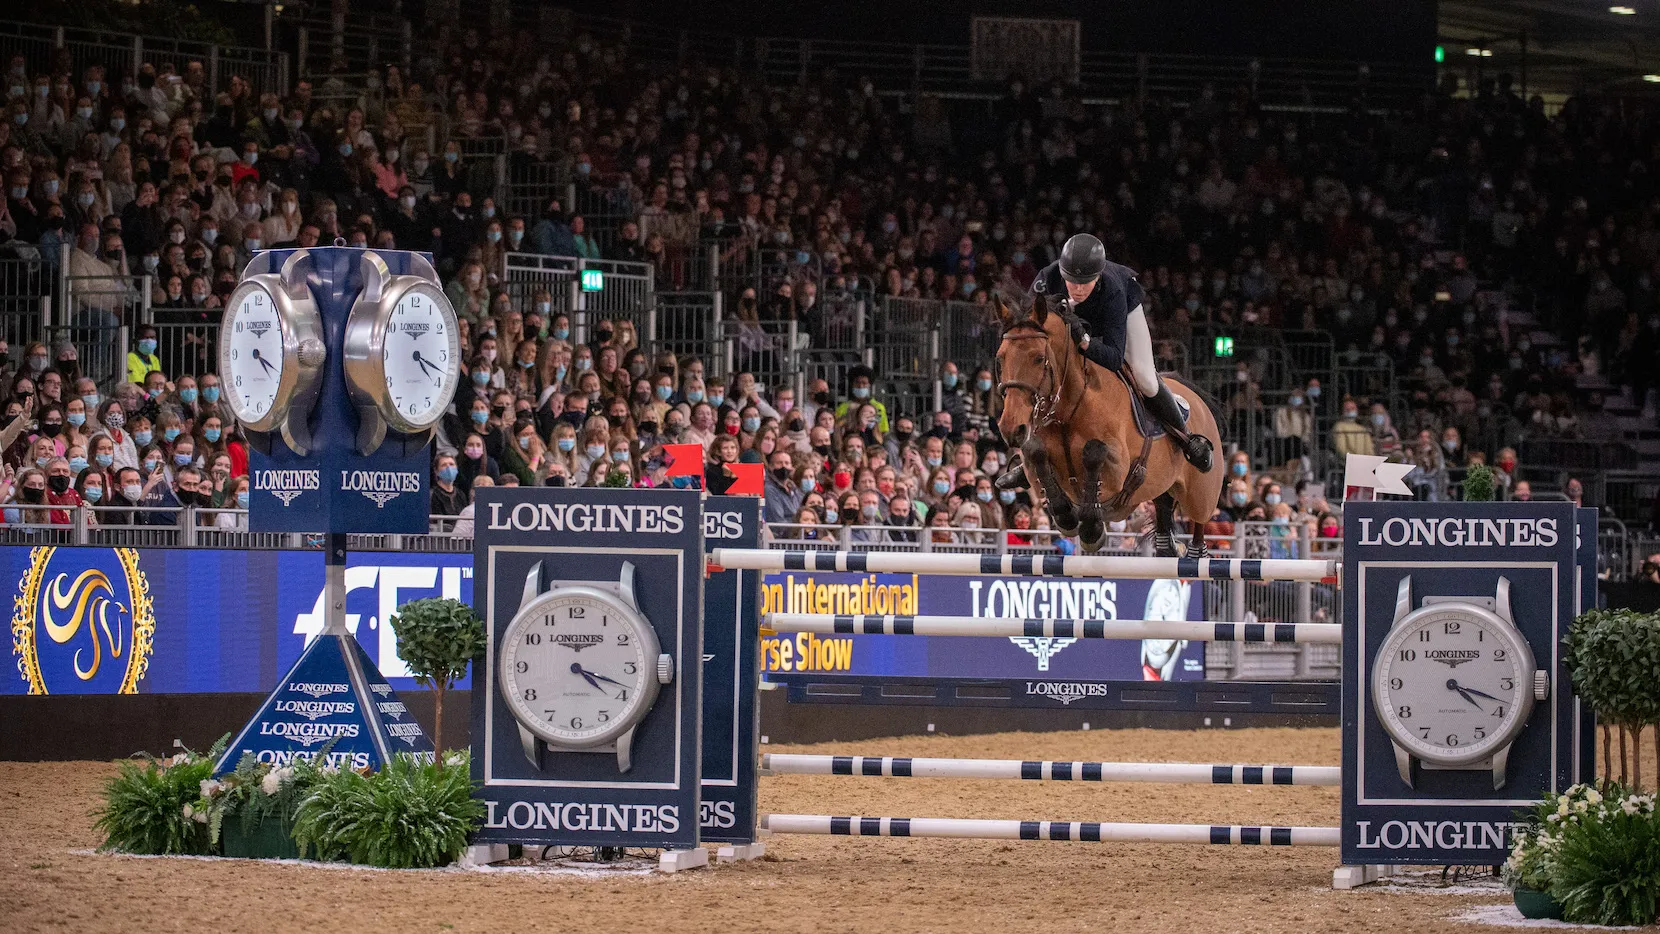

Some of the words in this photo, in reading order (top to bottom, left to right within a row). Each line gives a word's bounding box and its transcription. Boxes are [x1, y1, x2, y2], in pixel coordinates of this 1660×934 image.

[254, 294, 263, 306] 12
[411, 296, 420, 308] 12
[244, 302, 250, 314] 11
[398, 304, 404, 315] 11
[235, 321, 243, 333] 10
[246, 321, 272, 330] LONGINES
[400, 322, 430, 331] LONGINES
[436, 322, 443, 335] 2
[232, 348, 238, 361] 9
[439, 349, 447, 362] 3
[235, 375, 242, 387] 8
[434, 376, 441, 388] 4
[244, 395, 250, 407] 7
[256, 401, 262, 414] 6
[395, 396, 402, 408] 7
[424, 396, 431, 408] 5
[409, 403, 417, 416] 6
[254, 469, 320, 490] LONGINES
[341, 470, 420, 492] LONGINES
[488, 502, 684, 533] LONGINES
[1358, 517, 1559, 547] LONGINES
[787, 574, 919, 616] International
[969, 579, 1117, 620] LONGINES
[568, 607, 585, 619] 12
[544, 614, 555, 626] 11
[602, 615, 607, 627] 1
[1444, 622, 1461, 634] 12
[525, 633, 541, 646] 10
[550, 634, 604, 643] LONGINES
[617, 634, 629, 646] 2
[1420, 630, 1430, 642] 11
[1478, 630, 1483, 642] 1
[795, 632, 853, 671] Show
[1399, 649, 1416, 662] 10
[1424, 650, 1480, 659] LONGINES
[1493, 649, 1506, 662] 2
[516, 661, 529, 674] 9
[623, 661, 637, 675] 3
[288, 682, 349, 693] LONGINES
[1026, 682, 1108, 696] LONGINES
[1391, 677, 1403, 691] 9
[1500, 677, 1514, 691] 3
[524, 688, 537, 701] 8
[614, 689, 629, 701] 4
[275, 700, 355, 713] LONGINES
[376, 701, 407, 713] LONGINES
[1398, 705, 1412, 719] 8
[1490, 706, 1506, 718] 4
[544, 709, 556, 722] 7
[597, 710, 609, 722] 5
[570, 716, 583, 729] 6
[260, 722, 359, 737] LONGINES
[385, 723, 423, 737] LONGINES
[1419, 727, 1431, 739] 7
[1473, 726, 1486, 739] 5
[1446, 733, 1458, 747] 6
[243, 749, 369, 769] ONGINES
[484, 801, 680, 833] LONGINES
[1356, 820, 1526, 850] LONGIN
